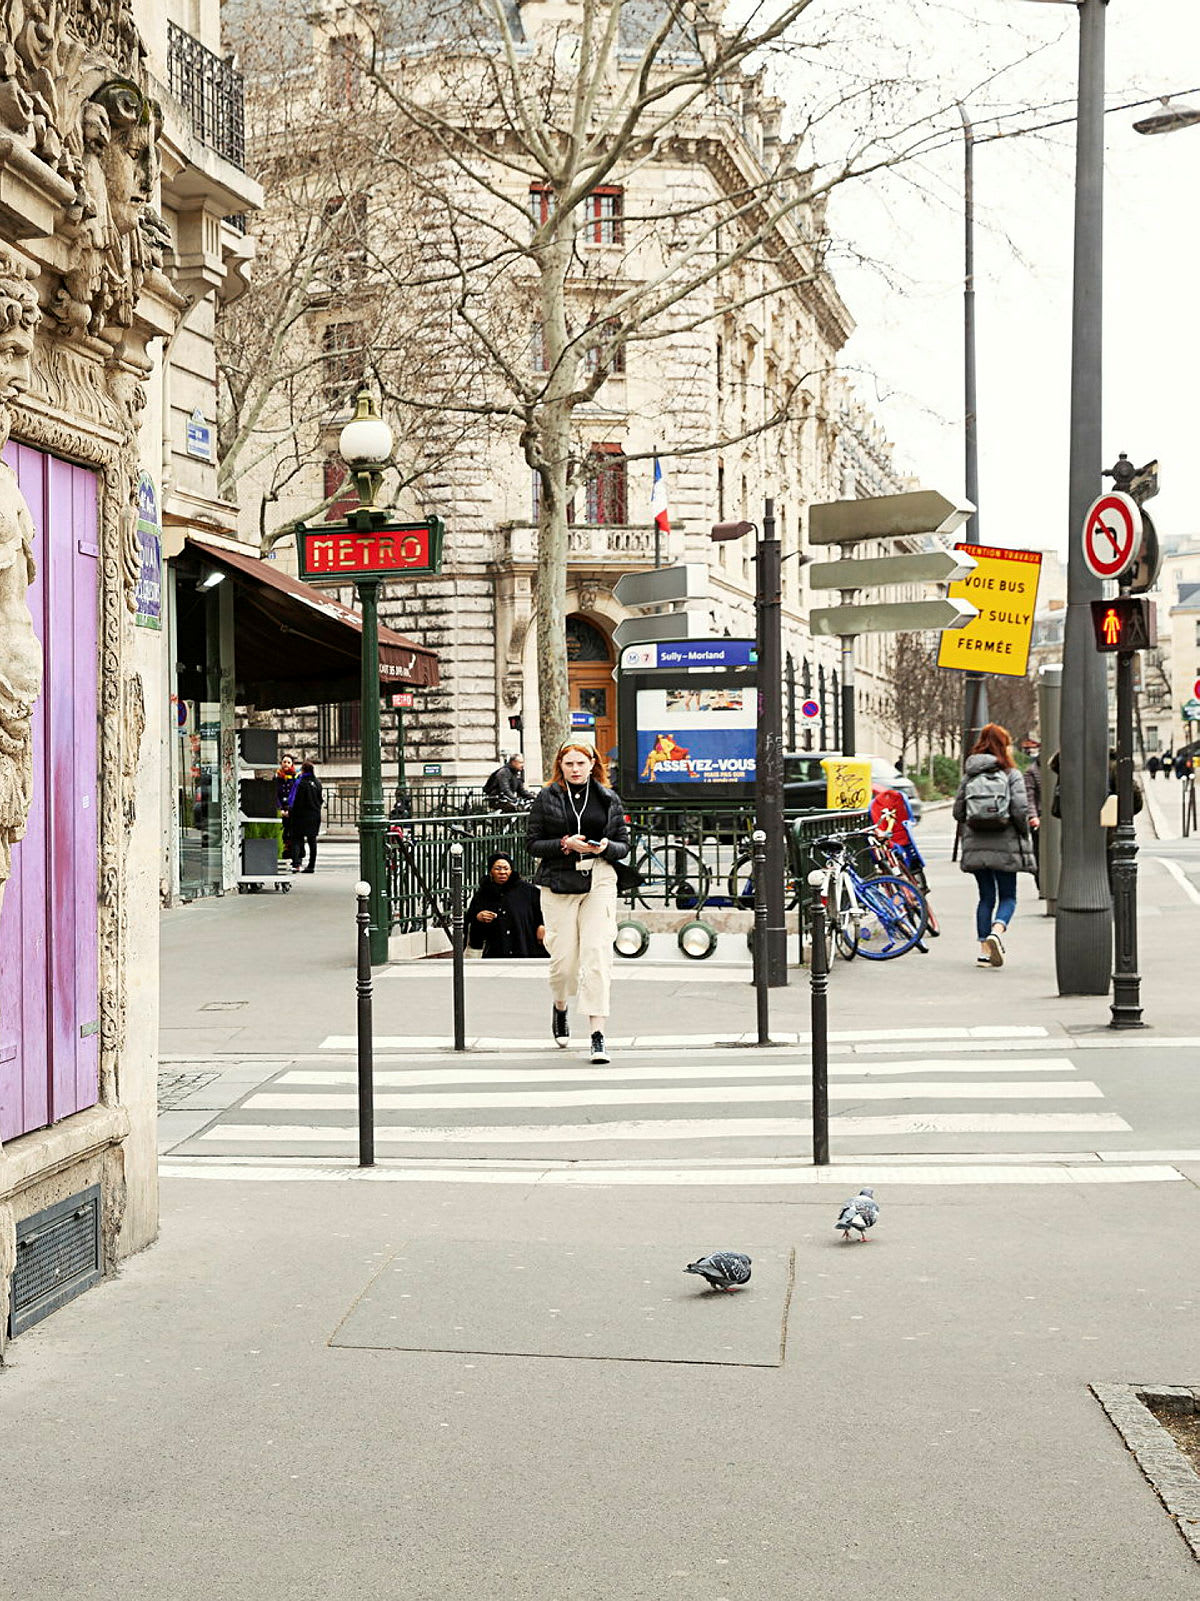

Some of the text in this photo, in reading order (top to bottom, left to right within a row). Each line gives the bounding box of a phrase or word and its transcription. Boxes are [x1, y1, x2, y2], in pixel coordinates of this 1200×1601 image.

[313, 536, 421, 567] METRO
[1004, 550, 1040, 562] TRAVAUX
[965, 576, 1025, 593] VOIE BUS
[989, 610, 1030, 625] SULLY
[957, 638, 1012, 654] FERMÉE
[653, 758, 756, 772] ASSEYEZ-VOUS
